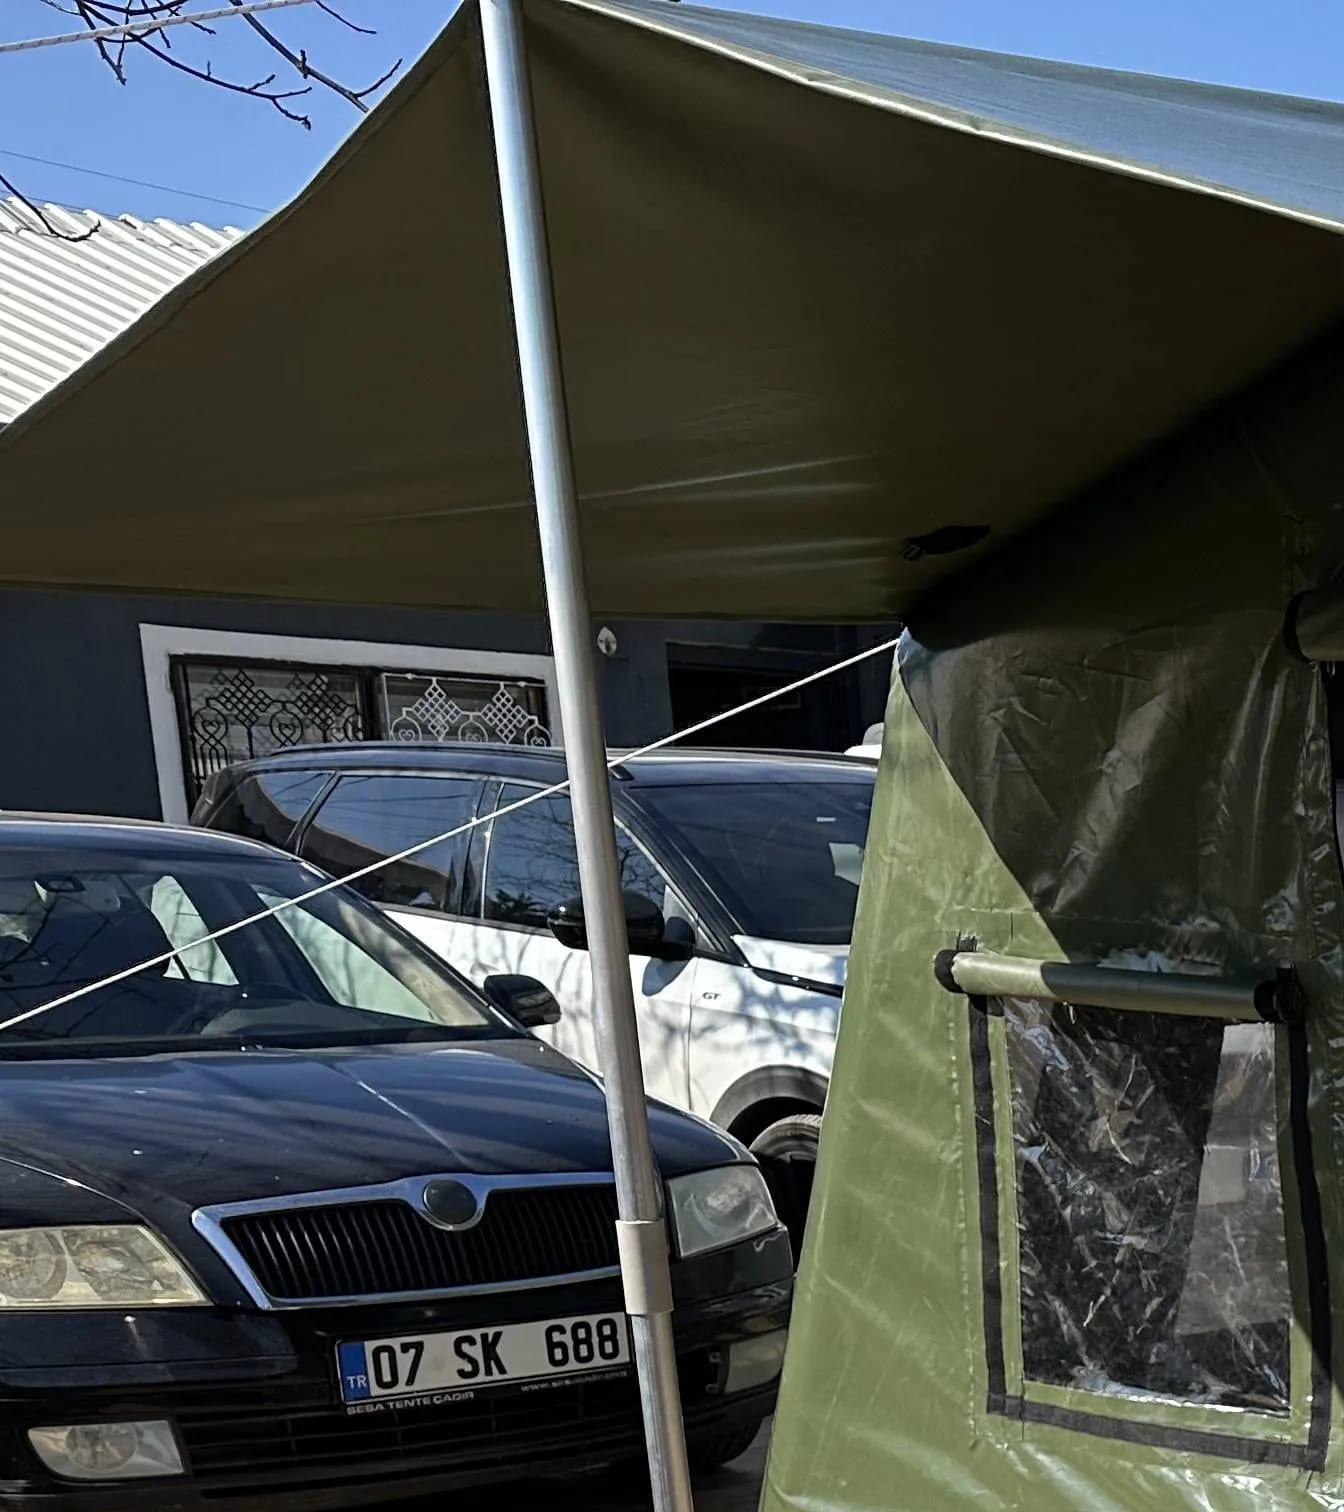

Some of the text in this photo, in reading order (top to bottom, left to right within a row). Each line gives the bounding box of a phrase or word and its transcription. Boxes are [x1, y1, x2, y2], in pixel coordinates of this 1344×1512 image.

[702, 991, 721, 1000] GT
[346, 1317, 620, 1390] TR 07 SK 688
[386, 1397, 431, 1410] TENTE
